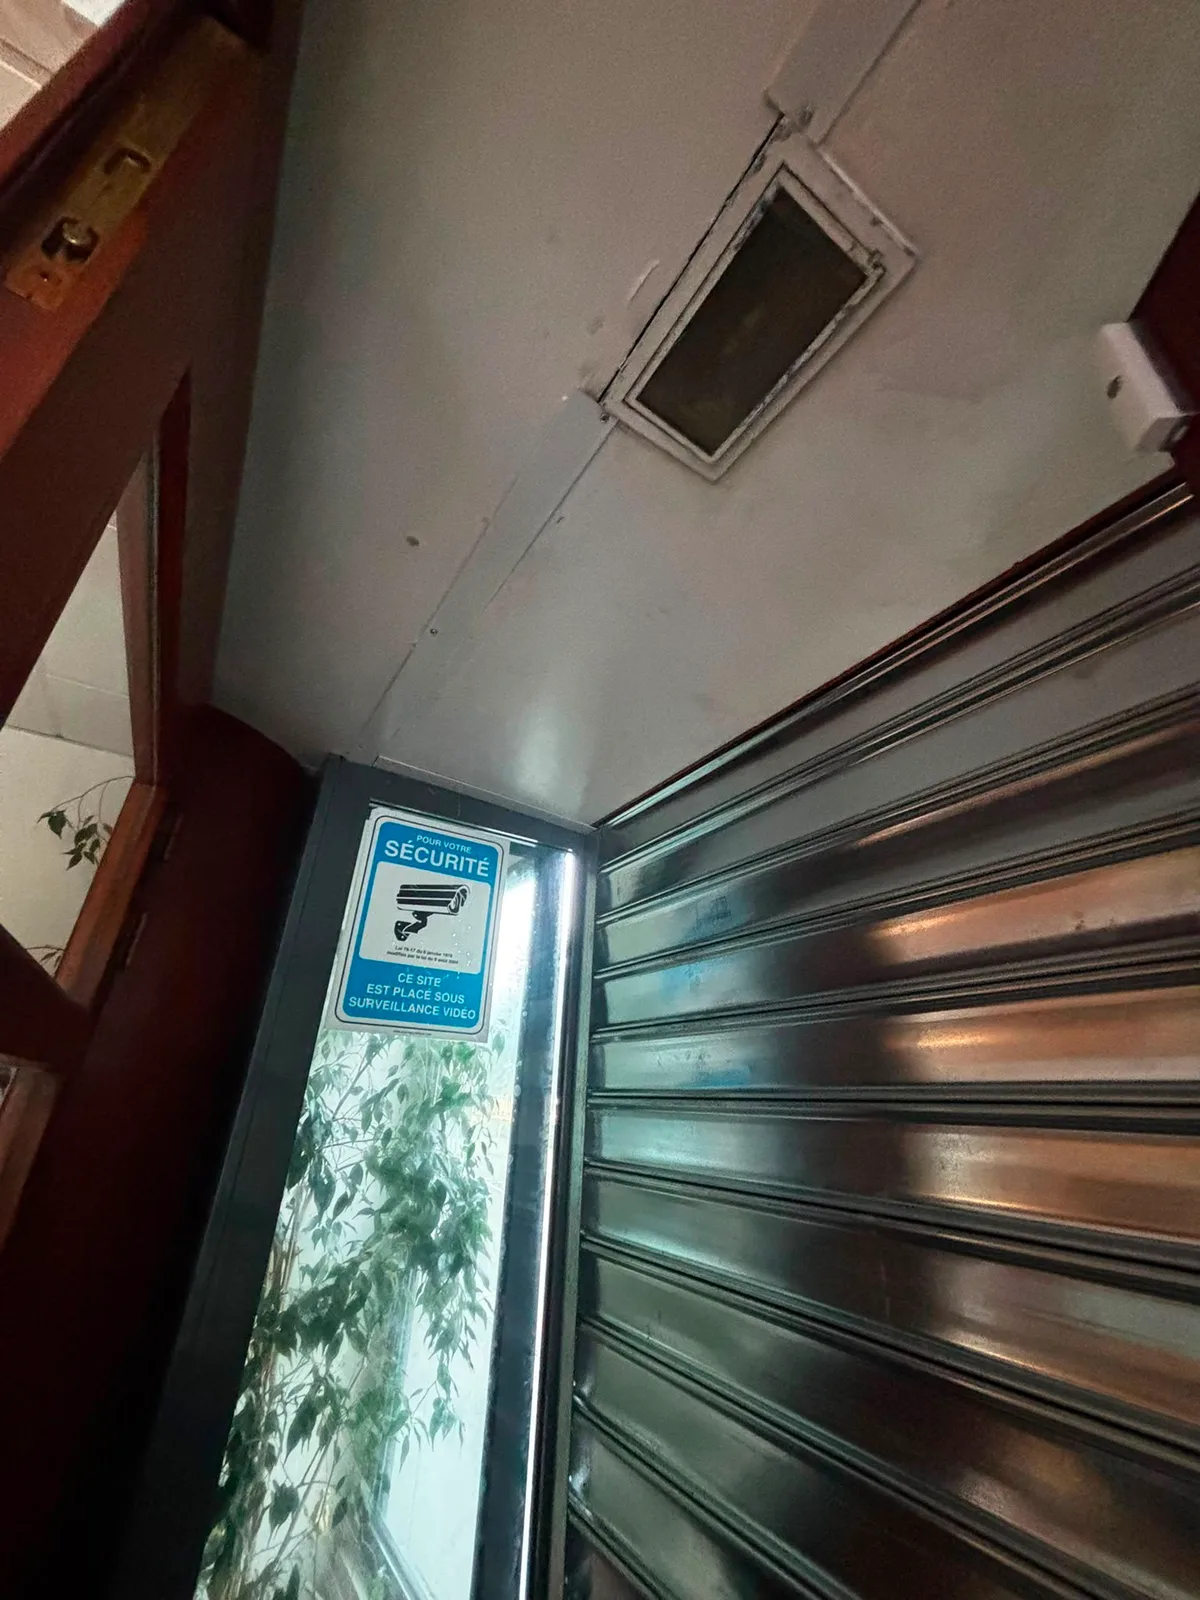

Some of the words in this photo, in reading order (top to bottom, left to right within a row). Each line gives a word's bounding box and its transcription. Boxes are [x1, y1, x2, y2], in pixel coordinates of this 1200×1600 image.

[416, 834, 441, 847] POUR
[443, 840, 472, 854] VOTRE
[384, 839, 490, 877] SÉCURITÉ
[397, 972, 413, 984] CE
[416, 975, 441, 987] SITE
[366, 983, 391, 996] EST
[392, 986, 432, 1000] PLACÉ
[434, 991, 465, 1004] SOUS
[348, 996, 440, 1016] SURVEILLANCE
[443, 1006, 476, 1020] VIDÉO
